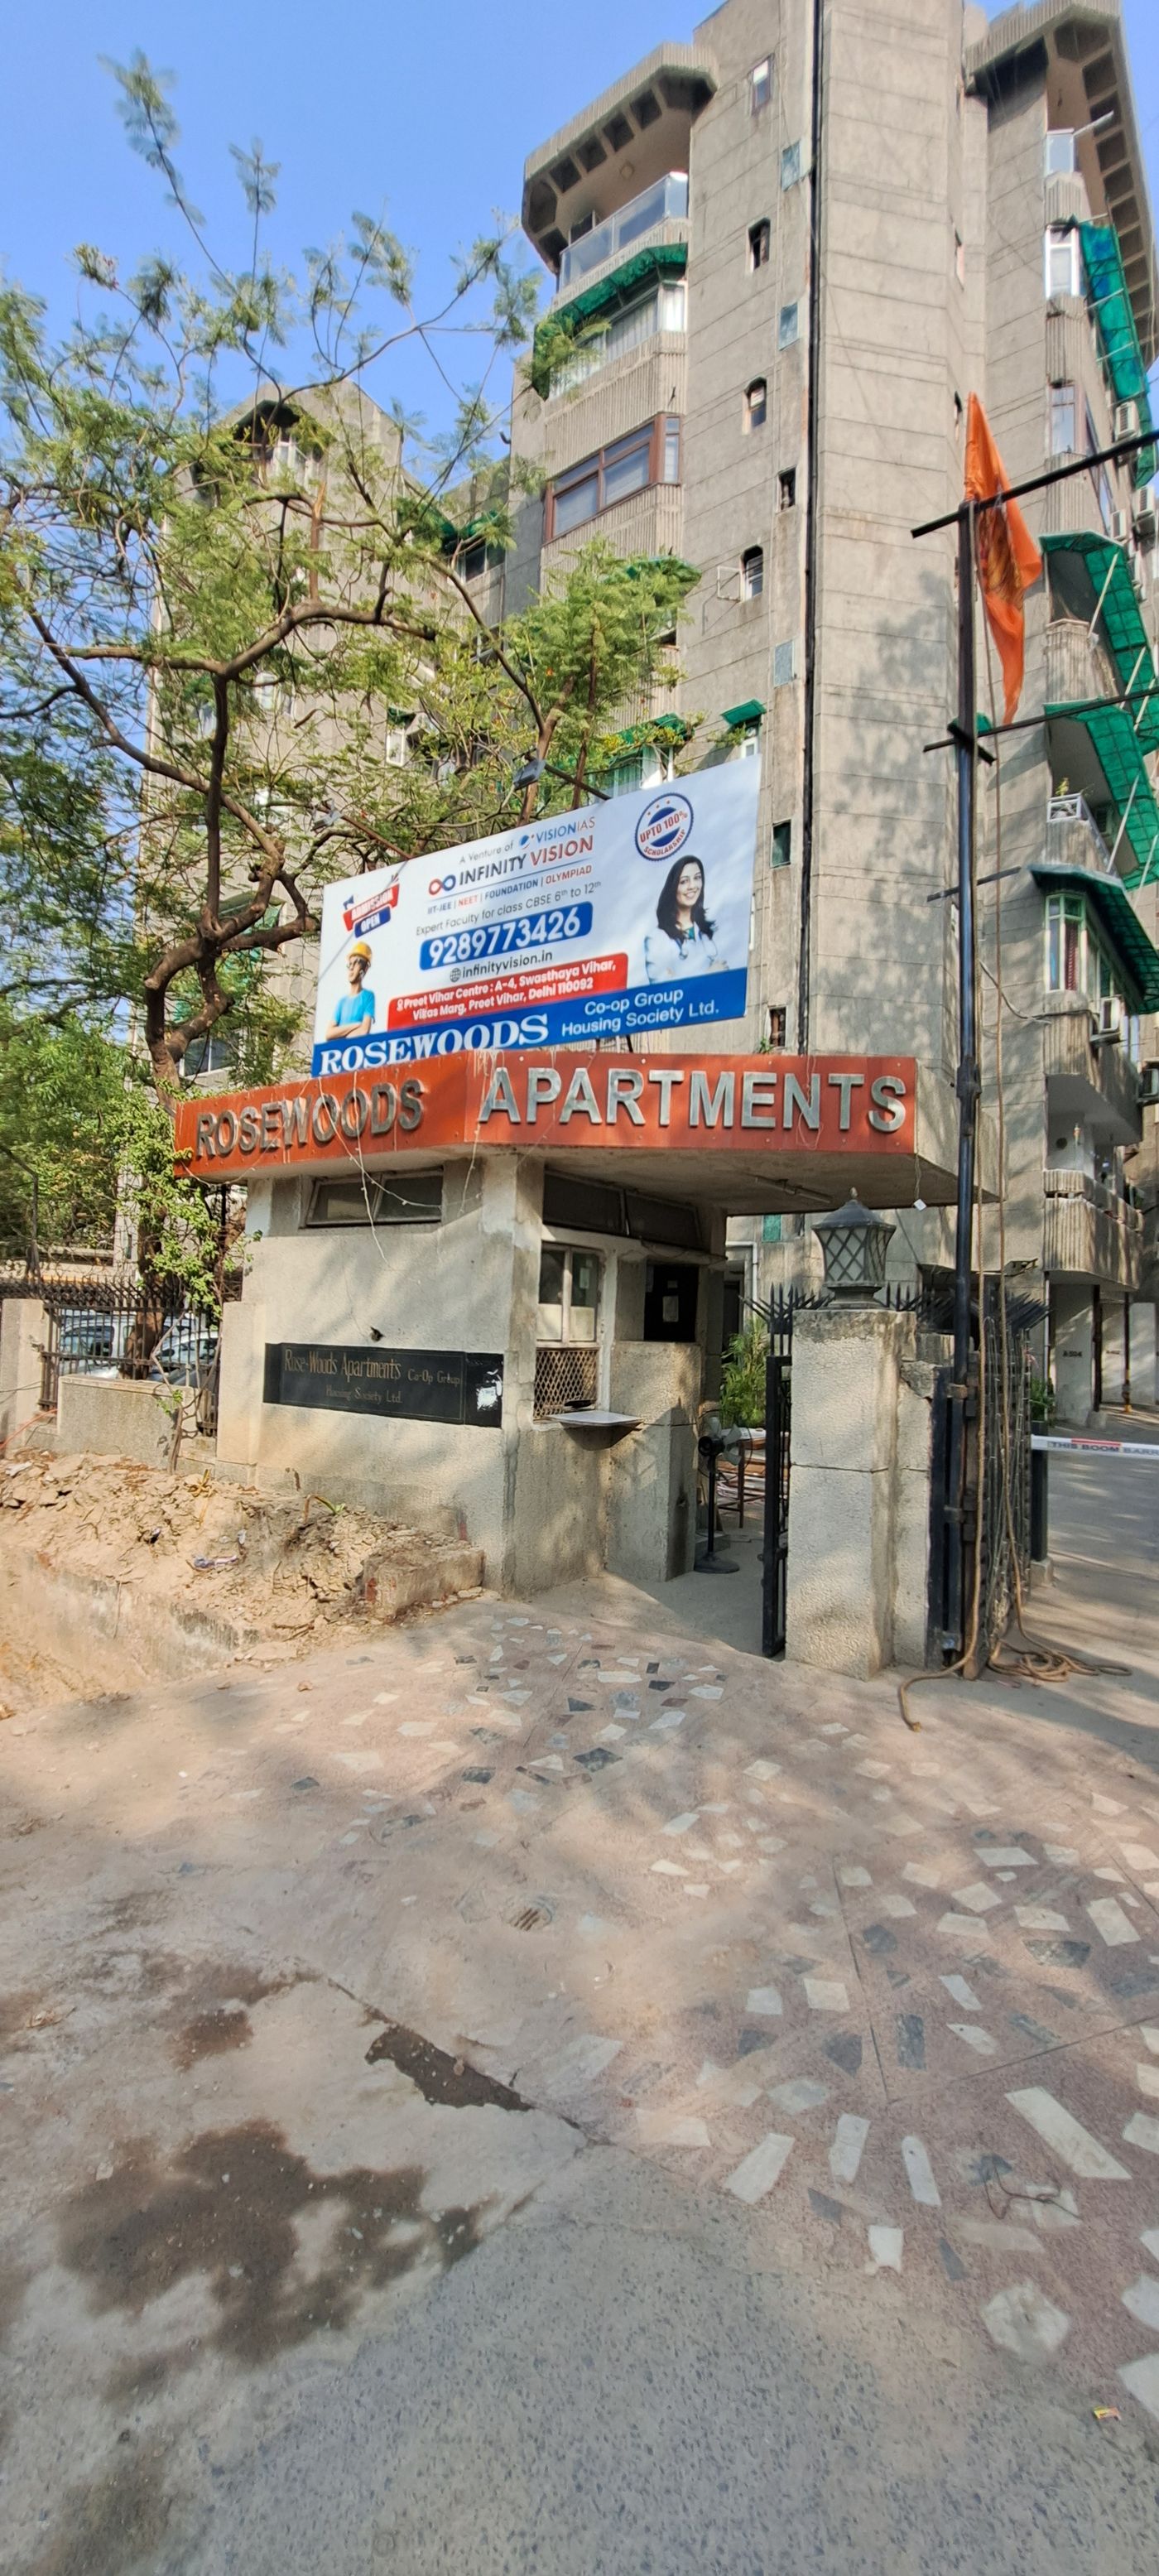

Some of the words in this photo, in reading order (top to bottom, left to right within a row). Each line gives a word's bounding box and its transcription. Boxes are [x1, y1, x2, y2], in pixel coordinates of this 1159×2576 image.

[640, 824, 661, 843] UPTO
[664, 811, 688, 829] 100%
[644, 829, 685, 855] SCHOLARSHIP
[459, 854, 527, 885] INFINITY
[530, 835, 594, 867] VISION
[469, 847, 501, 861] Venture
[504, 840, 513, 851] of
[416, 922, 444, 937] Expert
[445, 912, 479, 928] Faculty
[482, 906, 495, 919] for
[498, 903, 522, 917] class
[526, 893, 551, 909] CBSE
[555, 888, 568, 902] 6th
[570, 887, 581, 898] to
[584, 880, 602, 895] 12th
[428, 901, 452, 914] IIT-JEE
[459, 895, 478, 907] NEET
[485, 879, 538, 899] FOUNDATION
[546, 864, 592, 884] OLYMPIAD
[361, 912, 381, 932] OPEN
[430, 907, 581, 967] 9289773426
[404, 995, 428, 1009] Preet
[429, 991, 454, 1004] Vihar
[455, 985, 488, 999] Centre
[495, 977, 517, 991] A-4,
[519, 966, 580, 987] Swasthaya
[582, 961, 616, 975] Vihar,
[462, 951, 553, 979] infinityvision.in
[413, 1008, 438, 1020] Vikas
[440, 1003, 467, 1016] Marg,
[469, 996, 494, 1010] Preet
[497, 992, 527, 1006] Vihar,
[528, 983, 556, 999] Delhi
[558, 977, 594, 994] 110092
[562, 1016, 622, 1037] Housing
[626, 1008, 684, 1028] Society
[689, 999, 719, 1018] Ltd.
[584, 998, 630, 1016] Co-op
[634, 989, 684, 1008] Group
[319, 1013, 550, 1076] ROSEWOODS
[196, 1078, 426, 1157] ROSEWOODS
[479, 1067, 907, 1133] APARTMENTS
[340, 1352, 402, 1383] Apartments
